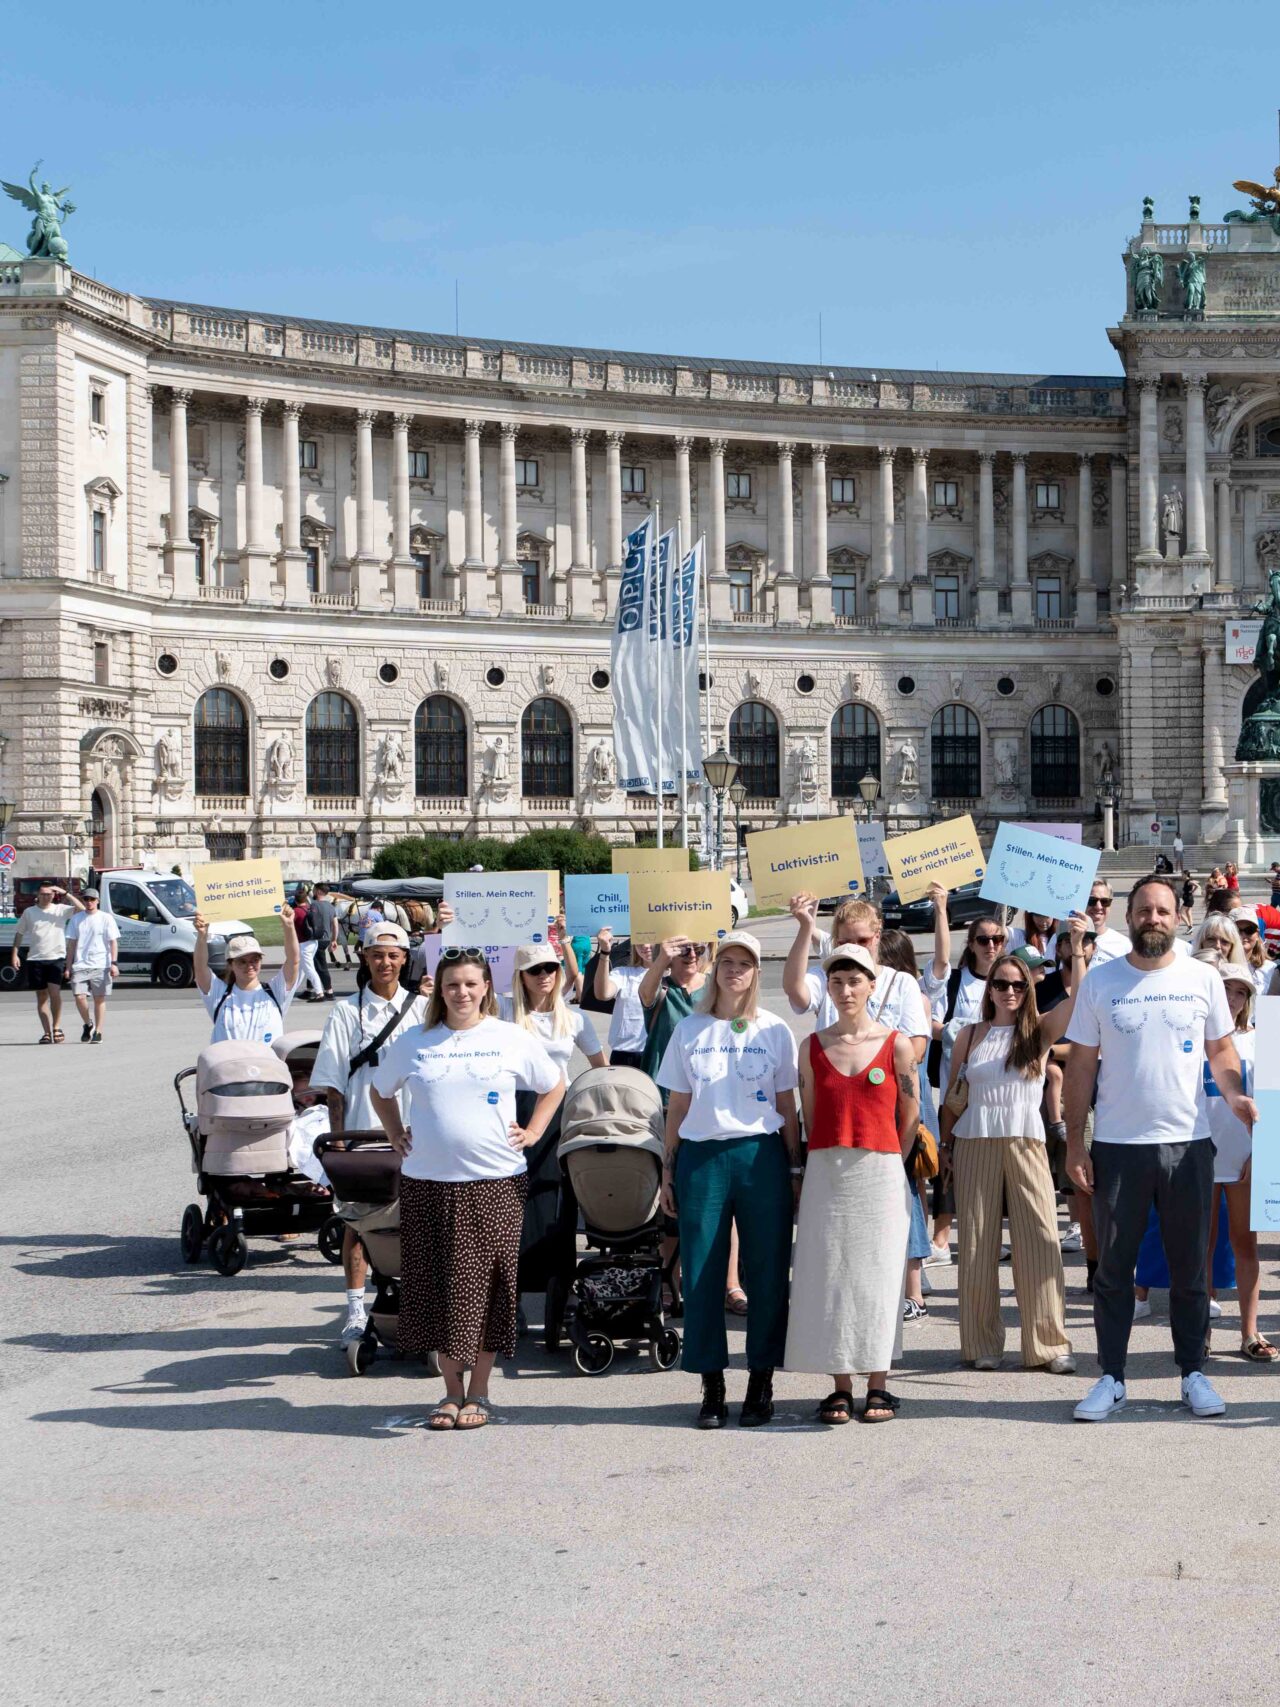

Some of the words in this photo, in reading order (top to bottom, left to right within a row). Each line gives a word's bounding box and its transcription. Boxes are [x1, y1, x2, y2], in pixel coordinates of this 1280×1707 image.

[901, 855, 918, 865] Wir
[920, 848, 939, 860] sind
[941, 842, 958, 854] still
[1006, 844, 1034, 859] Stillen.
[1036, 853, 1057, 865] Mein
[1059, 859, 1084, 873] Recht.
[770, 851, 839, 872] Laktivist:in
[901, 867, 923, 878] aber
[925, 858, 948, 871] nicht
[950, 849, 975, 863] leise!
[206, 882, 222, 890] Wir
[225, 880, 244, 889] sind
[246, 878, 262, 886] still
[204, 893, 225, 902] aber
[228, 890, 251, 899] nicht
[253, 887, 276, 896] leise!
[455, 890, 484, 898] Stillen.
[486, 890, 507, 898] Mein
[509, 890, 536, 898] Recht.
[597, 893, 622, 903] Chill,
[591, 905, 606, 913] ich
[608, 905, 629, 913] still!
[648, 901, 712, 913] Laktivist:in
[1111, 997, 1141, 1006] Stillen.
[1144, 994, 1167, 1002] Mein
[1169, 994, 1196, 1002] Recht.
[448, 1051, 472, 1059] Mein
[719, 1045, 741, 1053] Mein
